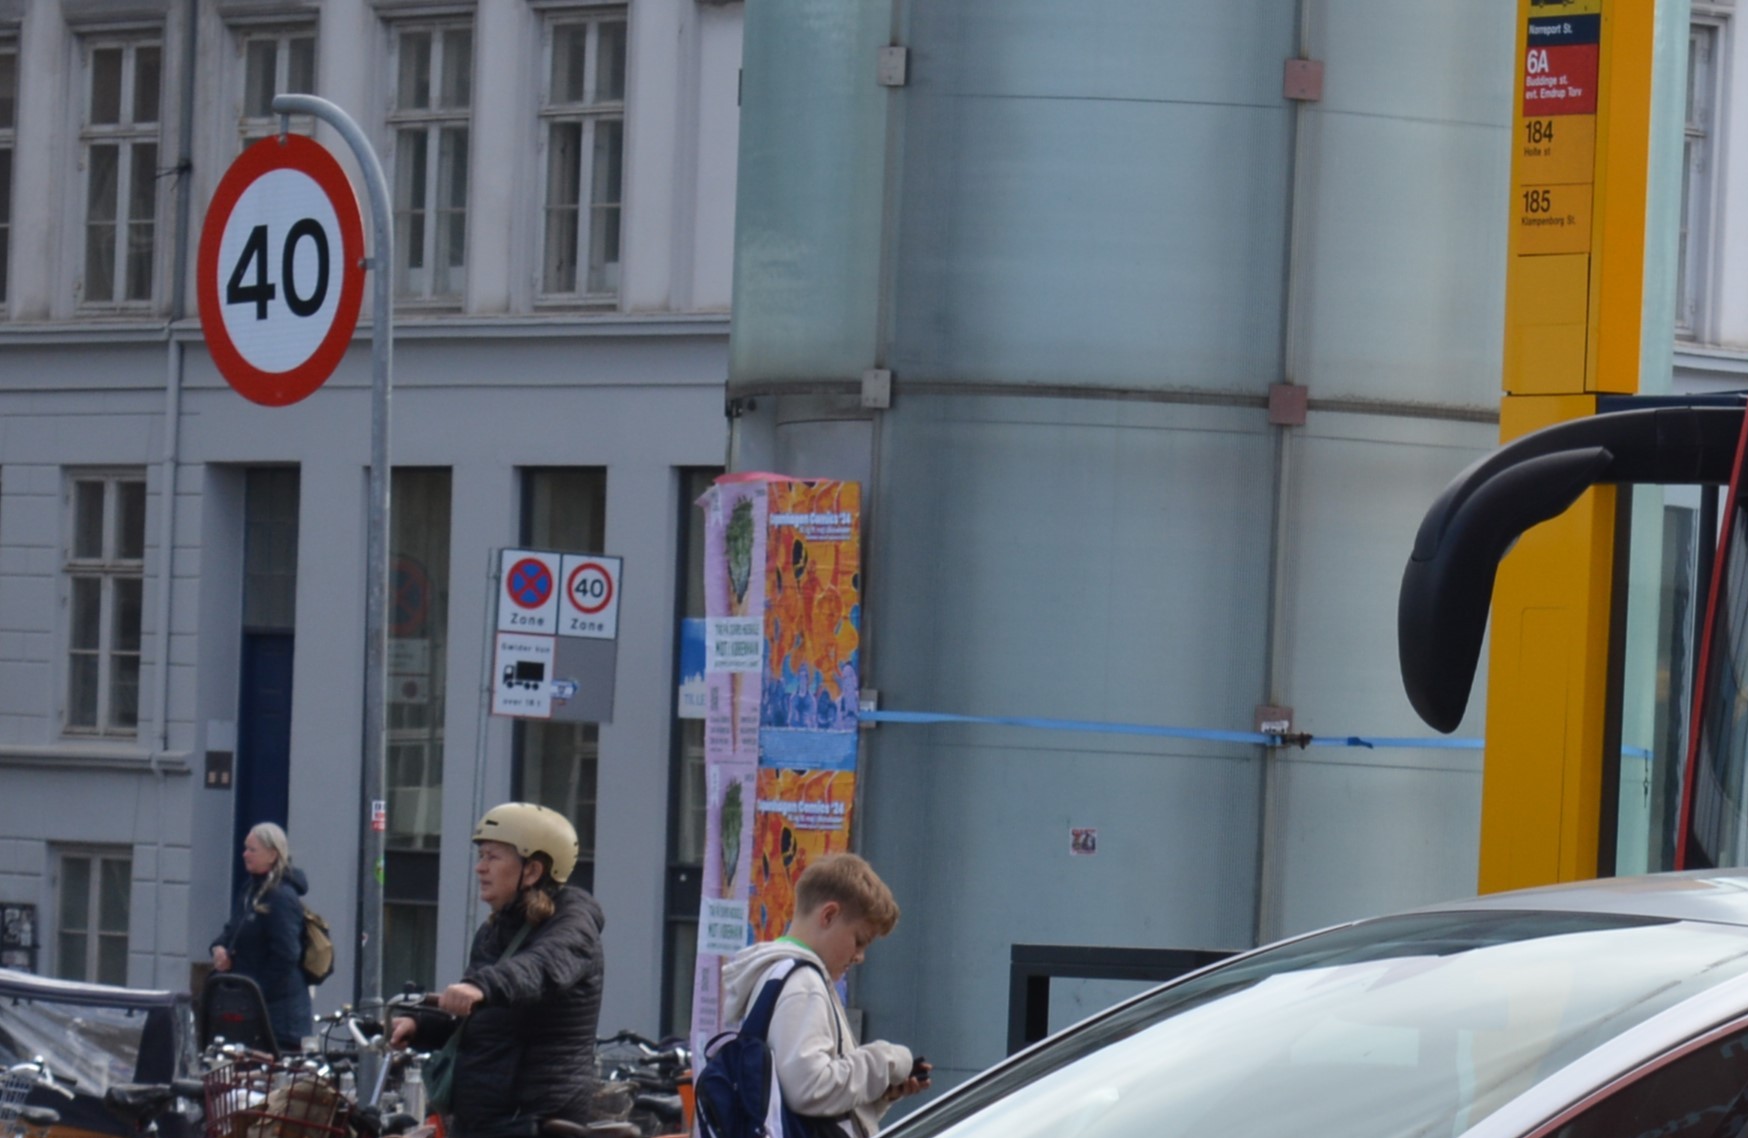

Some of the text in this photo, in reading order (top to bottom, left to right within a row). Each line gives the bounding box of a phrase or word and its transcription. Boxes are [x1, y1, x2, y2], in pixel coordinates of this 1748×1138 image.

[1527, 49, 1549, 74] 6A
[1525, 120, 1553, 143] 184
[1522, 189, 1551, 213] 185
[226, 217, 330, 320] 40
[574, 578, 604, 598] 40
[510, 612, 544, 627] Zone
[571, 618, 604, 632] Zone
